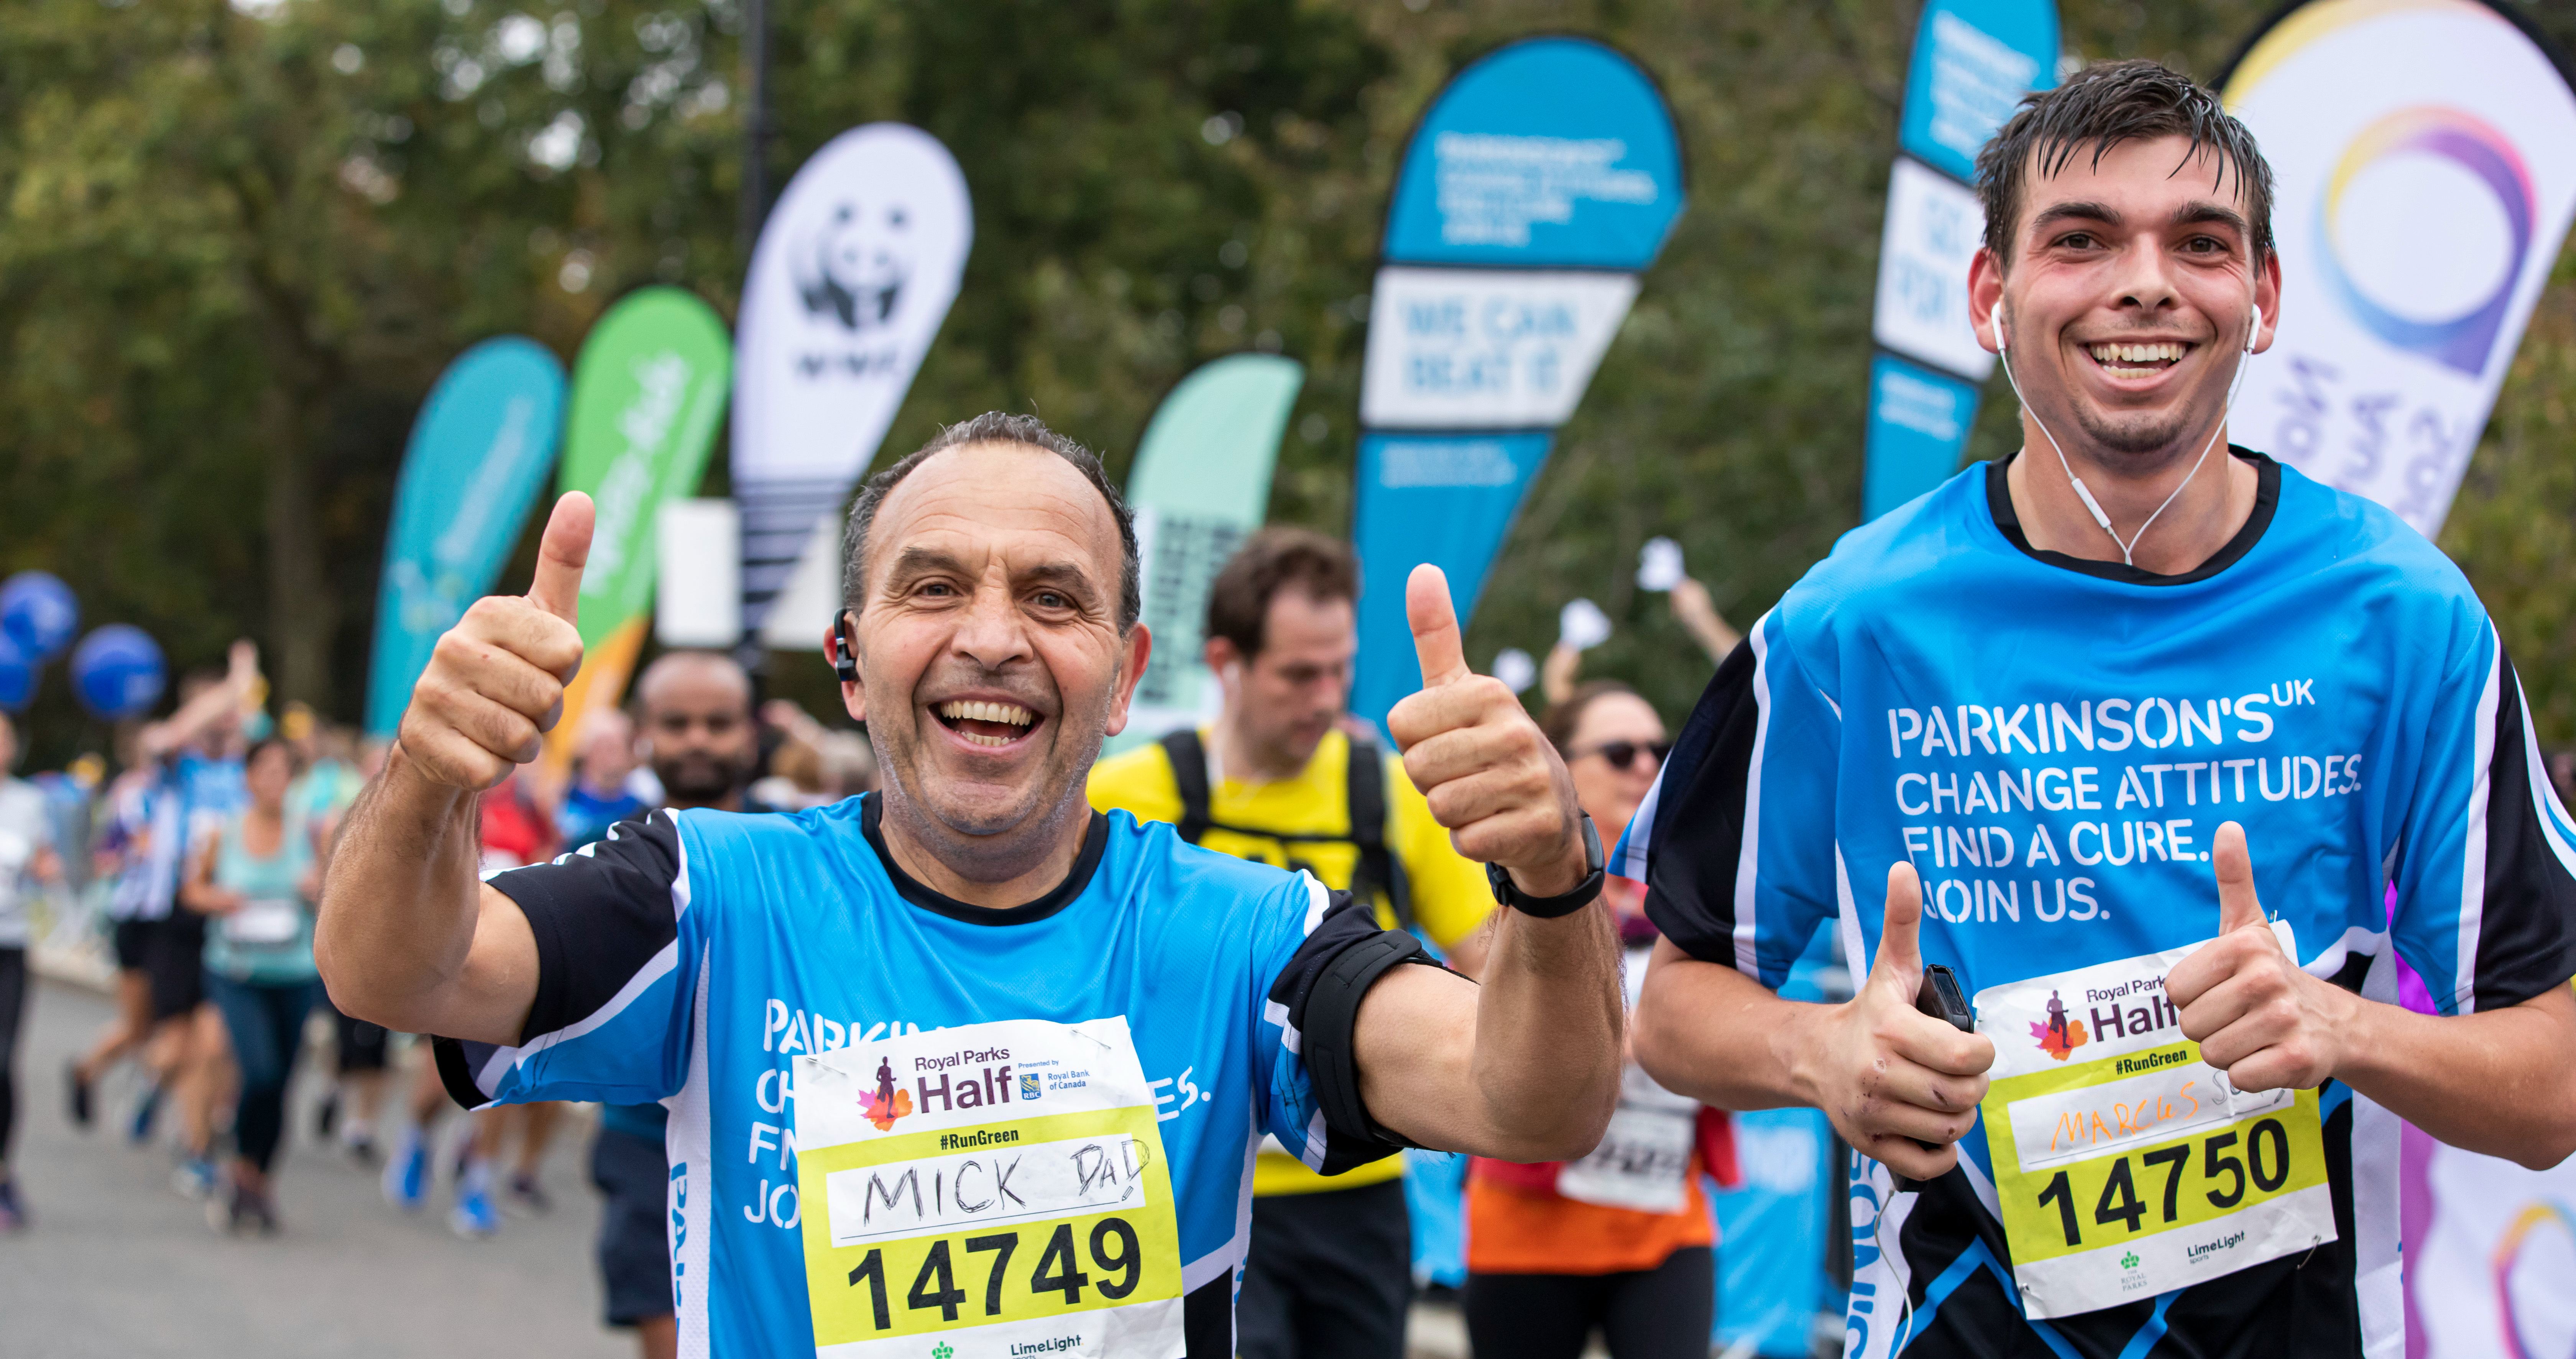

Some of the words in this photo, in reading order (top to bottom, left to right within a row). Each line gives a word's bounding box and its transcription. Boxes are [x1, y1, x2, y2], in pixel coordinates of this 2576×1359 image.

[1888, 693, 2274, 758] PARKINSON'S
[2271, 678, 2315, 707] UK
[1895, 766, 2102, 816] CHANGE
[2115, 753, 2361, 810] ATTITUDES.
[1902, 826, 2014, 868] FIND
[2026, 823, 2060, 868] A
[2069, 818, 2210, 867] CURE.
[1924, 879, 2020, 924] JOIN
[2032, 876, 2110, 923] US.
[2086, 982, 2129, 1003] Royal
[2132, 975, 2167, 993] Park
[2090, 995, 2179, 1042] Half
[915, 1052, 960, 1072] Royal
[963, 1047, 1010, 1064] Parks
[1018, 1060, 1050, 1069] Presented
[2116, 1050, 2188, 1075] #RunGreen
[1048, 1071, 1070, 1082] Royal
[1071, 1069, 1090, 1078] Bank
[1050, 1082, 1057, 1090] of
[1058, 1079, 1086, 1089] Canada
[917, 1065, 1012, 1114] Half
[1023, 1091, 1041, 1099] RBC
[940, 1129, 1019, 1151] #RunGreen
[864, 1154, 1027, 1227] MICK
[1071, 1139, 1150, 1196] DAD
[2037, 1118, 2290, 1247] 14750
[2189, 1254, 2209, 1265] sports
[848, 1218, 1142, 1331] 14749
[2121, 1272, 2146, 1284] ROYAL
[2122, 1280, 2148, 1292] PARKS
